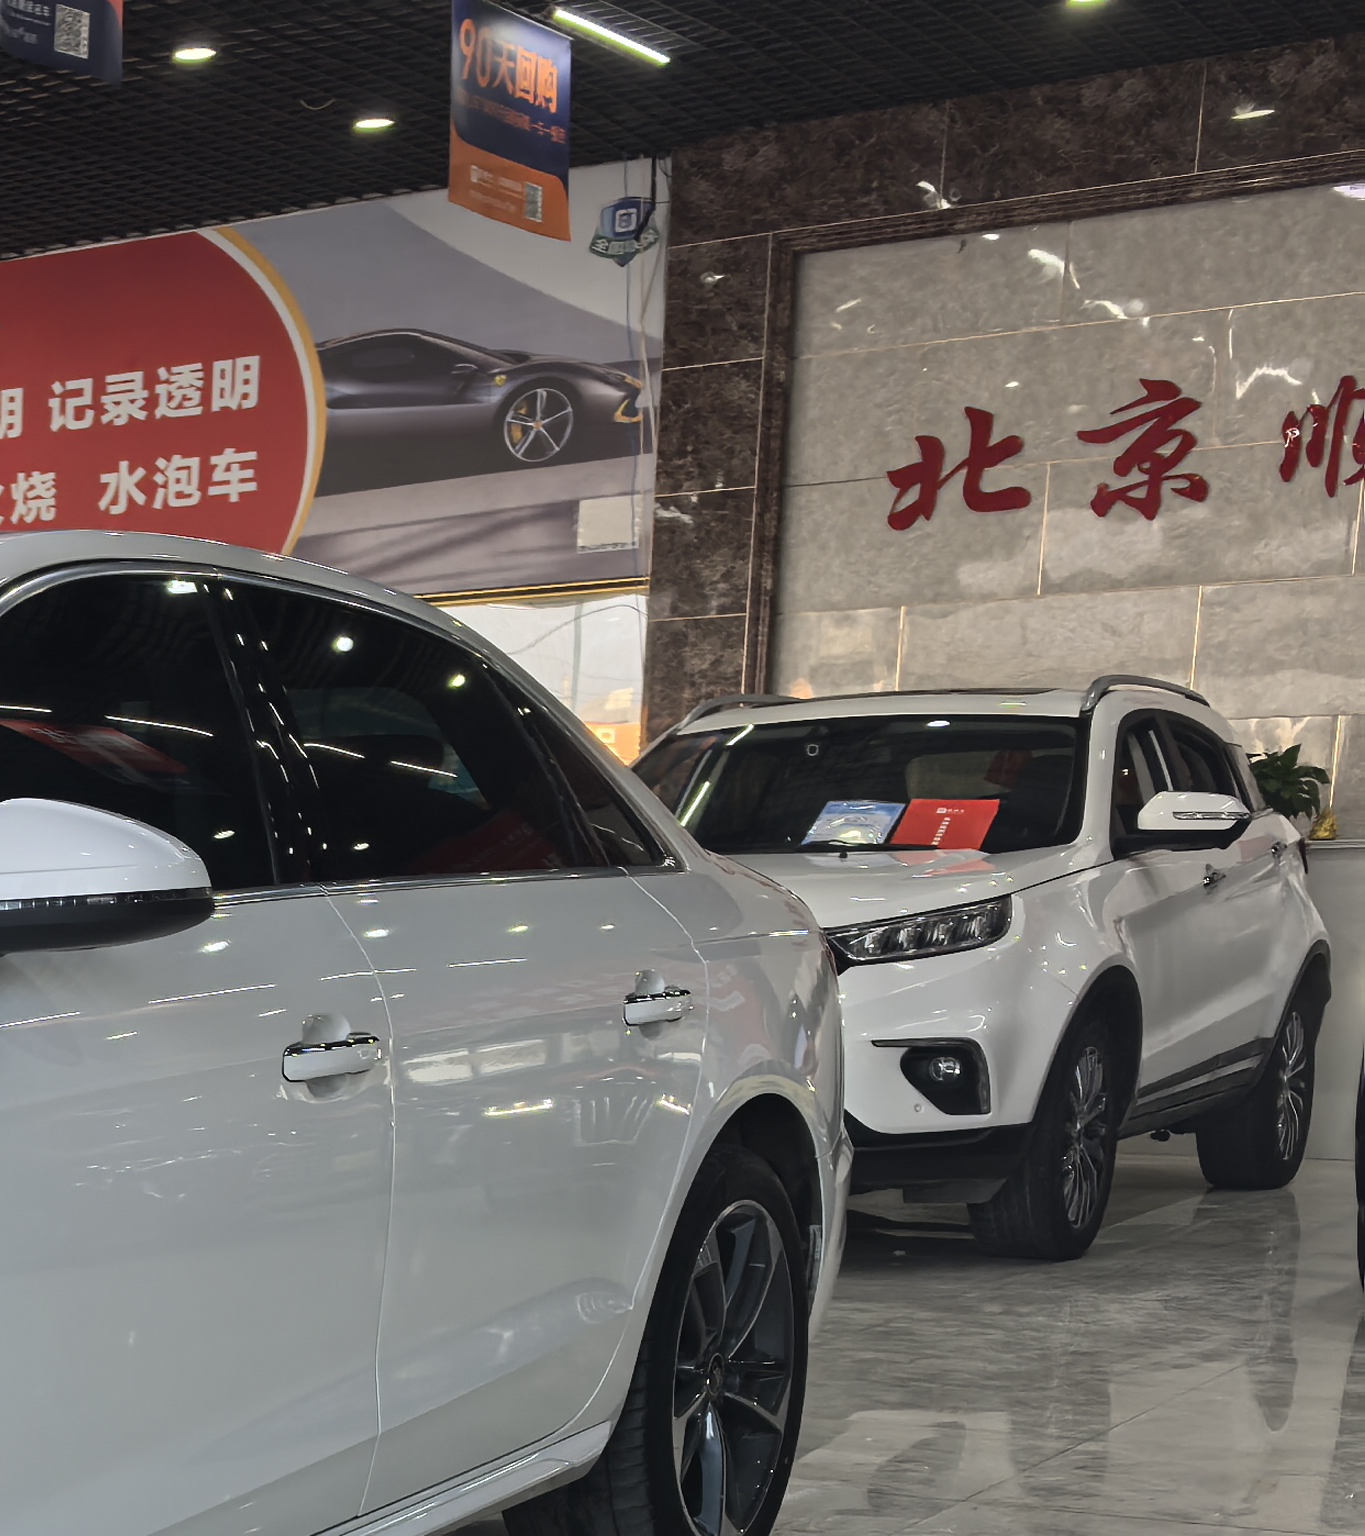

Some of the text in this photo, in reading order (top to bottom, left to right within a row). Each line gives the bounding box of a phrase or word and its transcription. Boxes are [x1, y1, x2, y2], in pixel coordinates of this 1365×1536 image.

[460, 18, 558, 114] 90天回购
[48, 355, 262, 432] 记录透明
[98, 447, 259, 515] 水泡车
